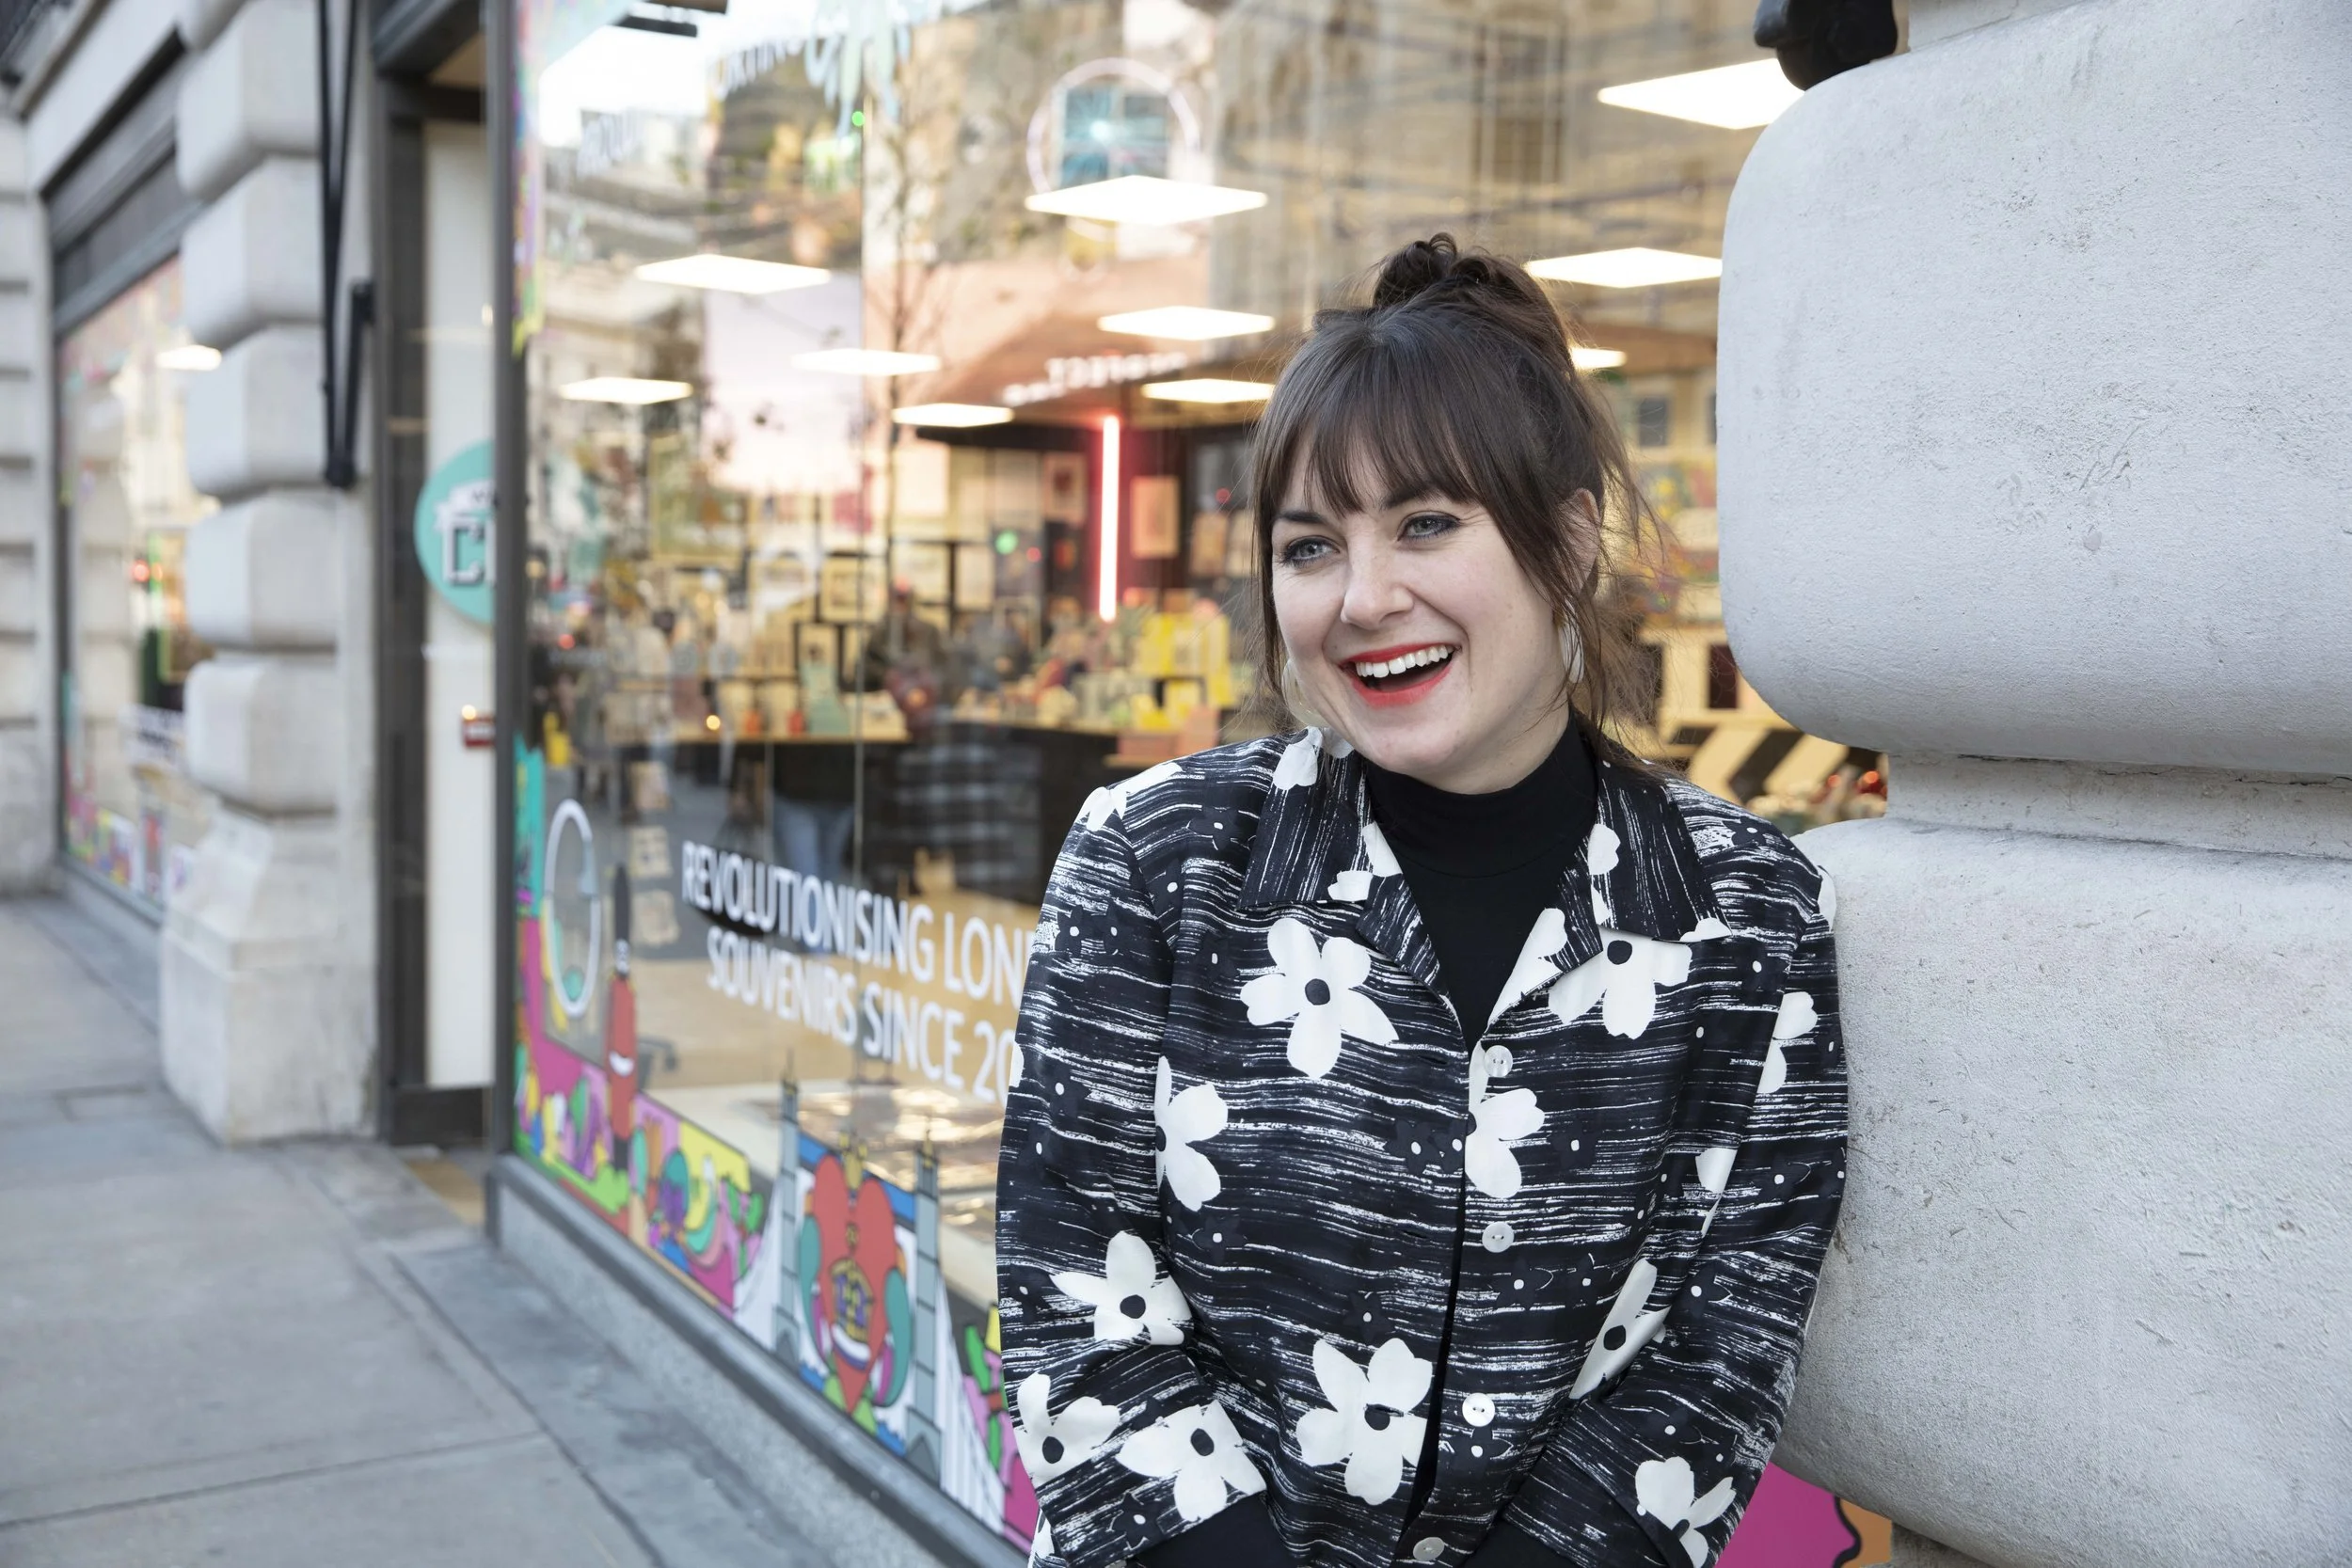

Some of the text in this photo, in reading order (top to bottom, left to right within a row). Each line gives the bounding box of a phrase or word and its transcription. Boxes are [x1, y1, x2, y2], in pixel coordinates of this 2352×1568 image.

[682, 840, 1036, 1009] REVOLUTIONISING LON
[707, 925, 857, 1047] SOUVENIRS
[862, 980, 964, 1089] SINCE
